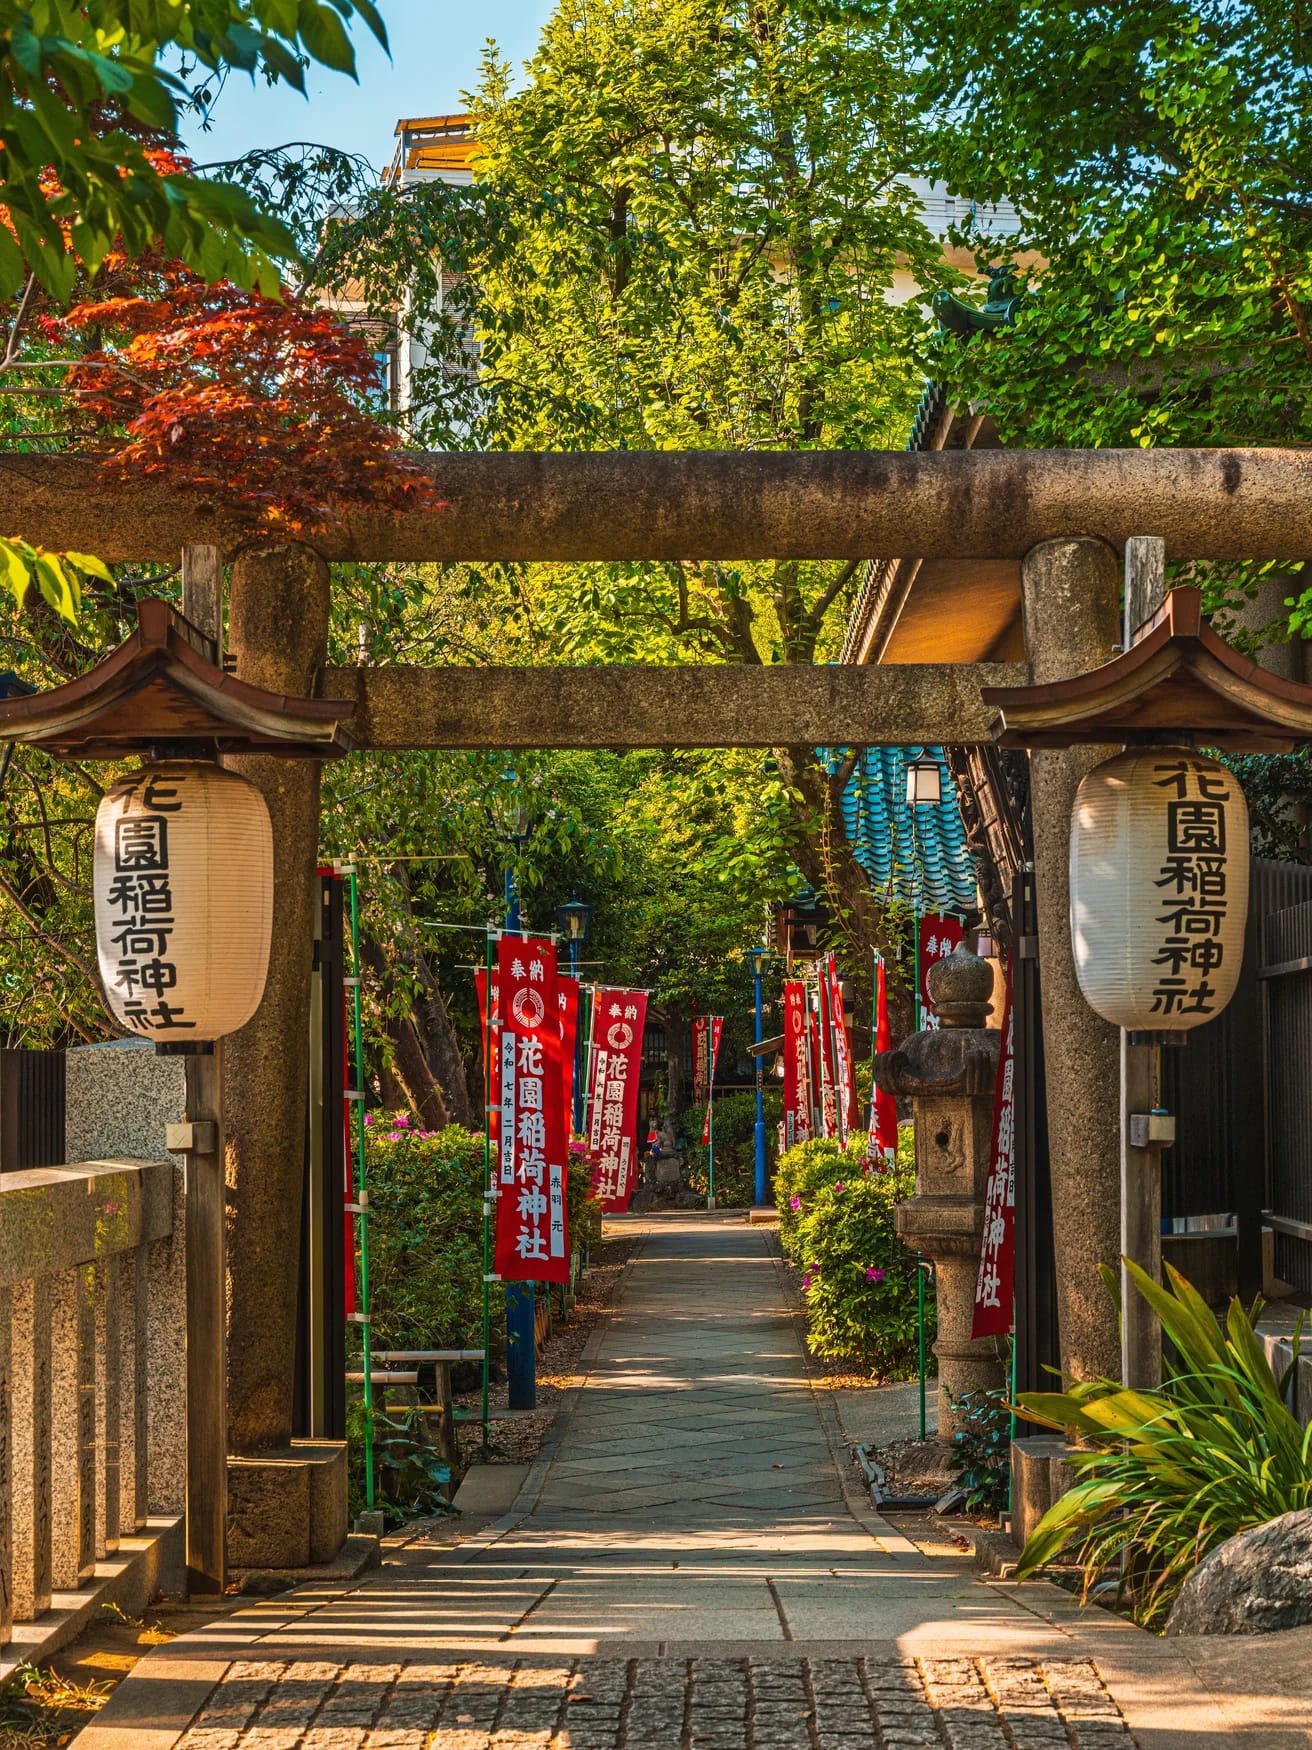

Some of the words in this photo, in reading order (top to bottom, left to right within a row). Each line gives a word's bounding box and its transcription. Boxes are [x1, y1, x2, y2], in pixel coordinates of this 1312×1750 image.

[106, 774, 197, 1030] 花園稲荷神社
[1150, 761, 1230, 1015] 花園稲荷神社
[511, 957, 544, 982] 奉納
[608, 1002, 638, 1021] 奉納
[503, 1042, 514, 1176] 令和七年二月吉日
[514, 1033, 549, 1261] 花園稲荷神社
[595, 1052, 629, 1201] 花園稲荷神社
